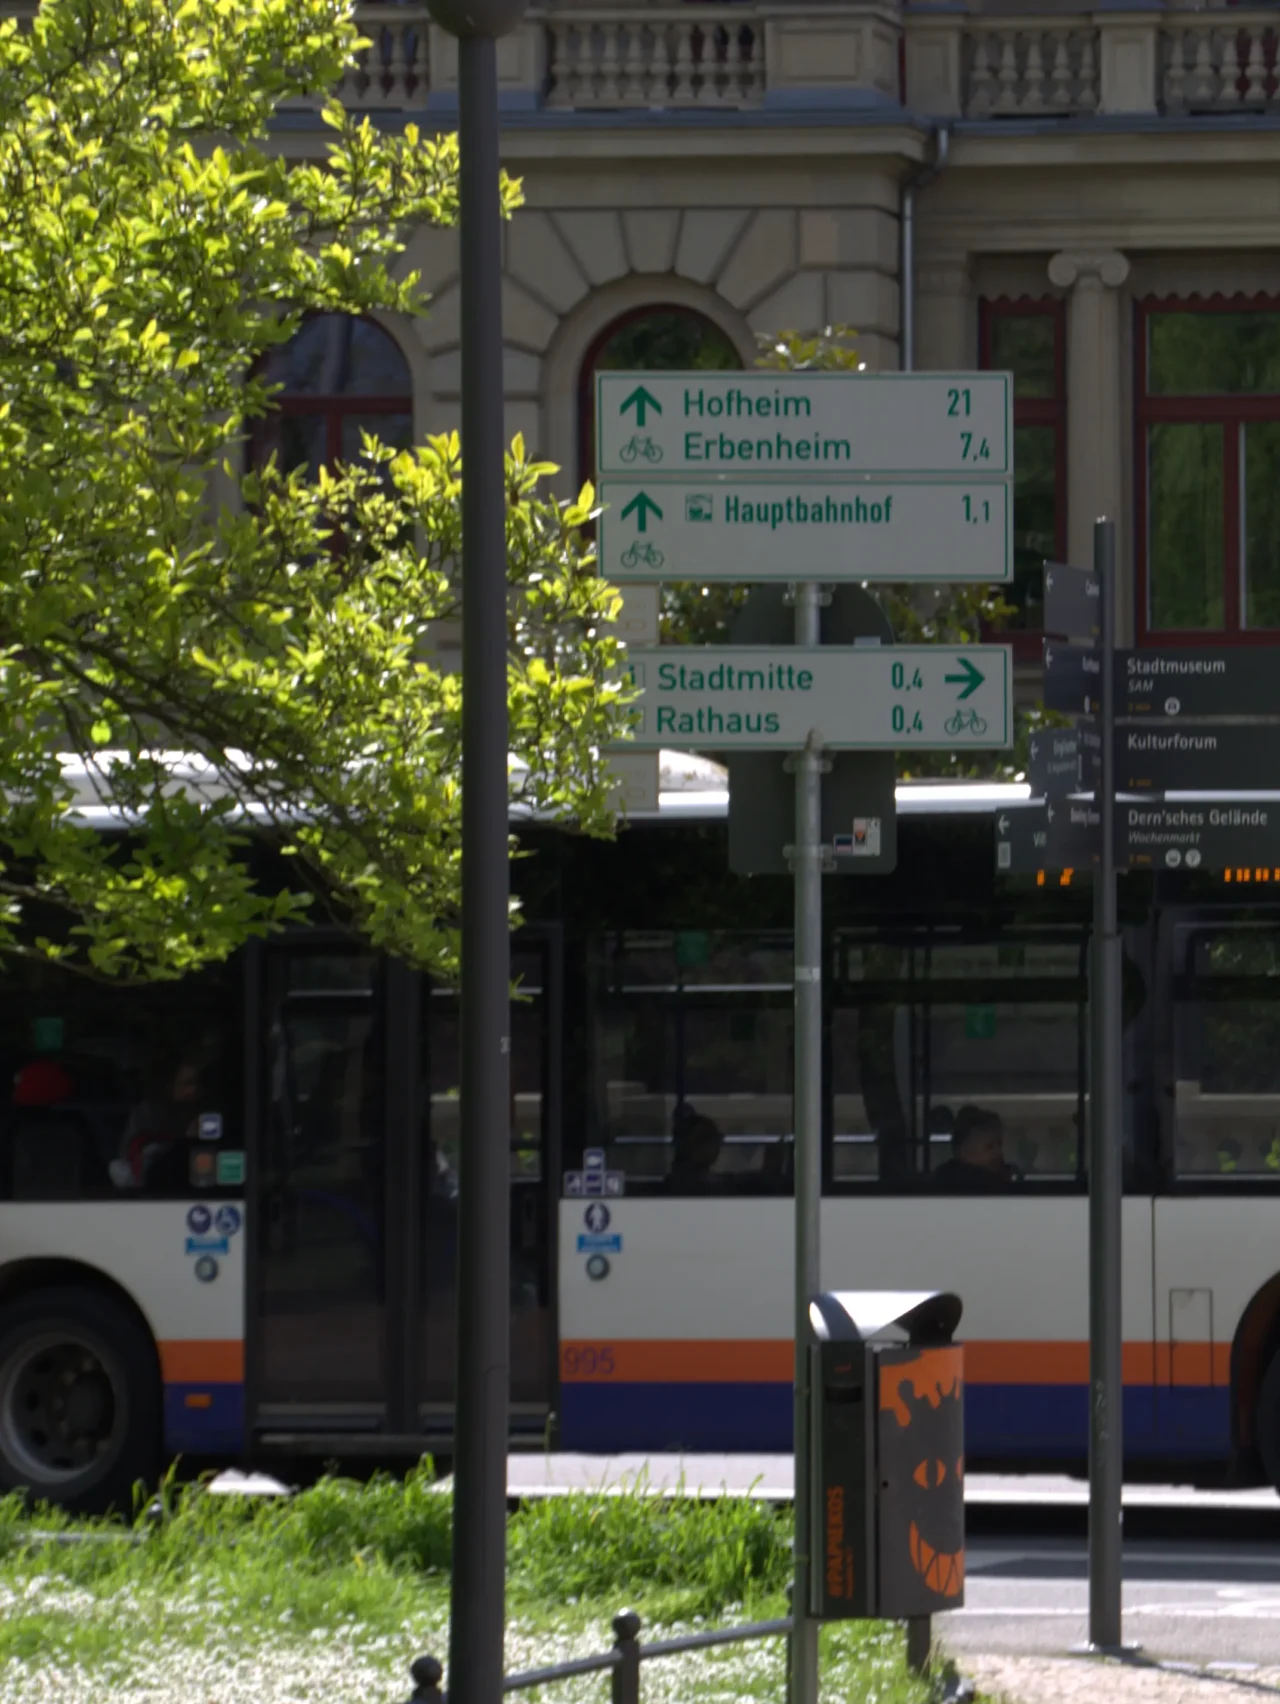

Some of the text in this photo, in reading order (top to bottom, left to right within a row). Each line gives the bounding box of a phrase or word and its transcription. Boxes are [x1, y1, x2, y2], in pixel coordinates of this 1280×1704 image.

[684, 389, 971, 418] Hofheim 21
[684, 432, 990, 461] Erbenheim 7,4
[725, 495, 990, 530] Hauptbahnhof 1,1
[657, 663, 923, 692] Stadtmitte 0,4
[1127, 658, 1225, 674] Stadtmuseum
[1127, 679, 1154, 692] SAM
[657, 706, 923, 734] Rathaus 0,4
[1127, 733, 1217, 749] Kulturforum
[1128, 808, 1268, 825] Dern'sches Gelände
[1128, 832, 1201, 844] Wochenmarkt
[563, 1346, 615, 1376] 995
